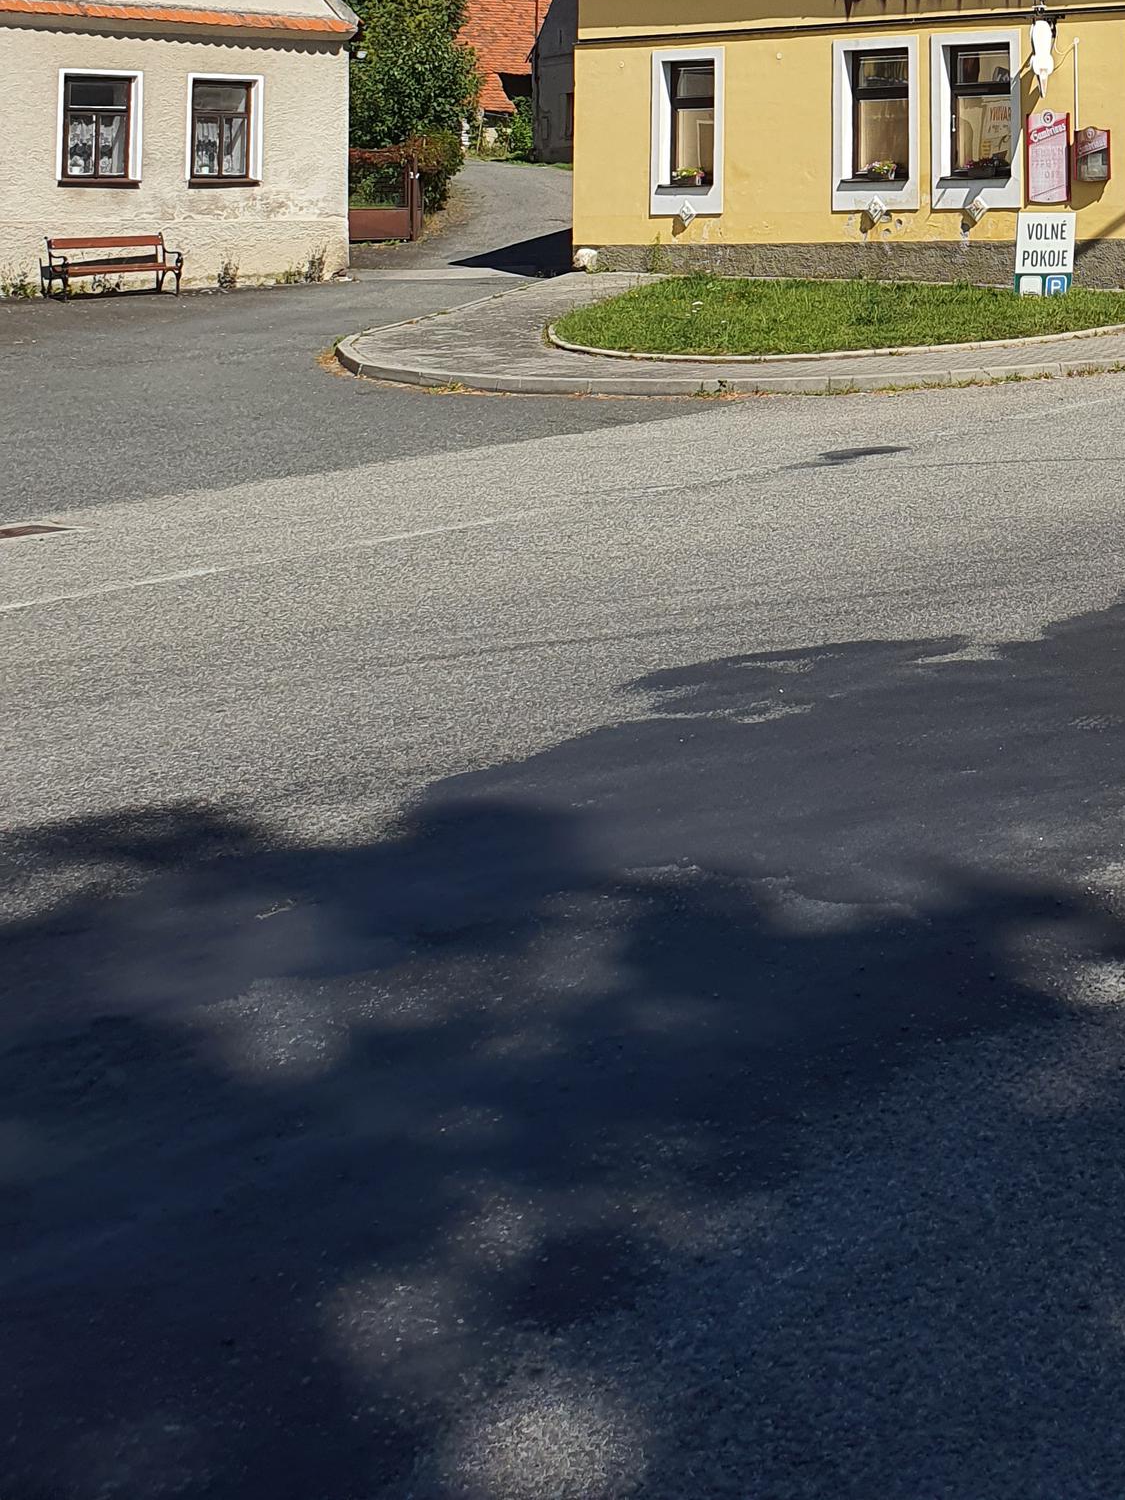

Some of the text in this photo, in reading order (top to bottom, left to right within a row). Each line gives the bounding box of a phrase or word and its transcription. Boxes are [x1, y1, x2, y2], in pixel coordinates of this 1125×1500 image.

[1027, 220, 1068, 240] VOLNÉ
[1022, 250, 1068, 267] POKOJE
[1050, 279, 1062, 295] P
